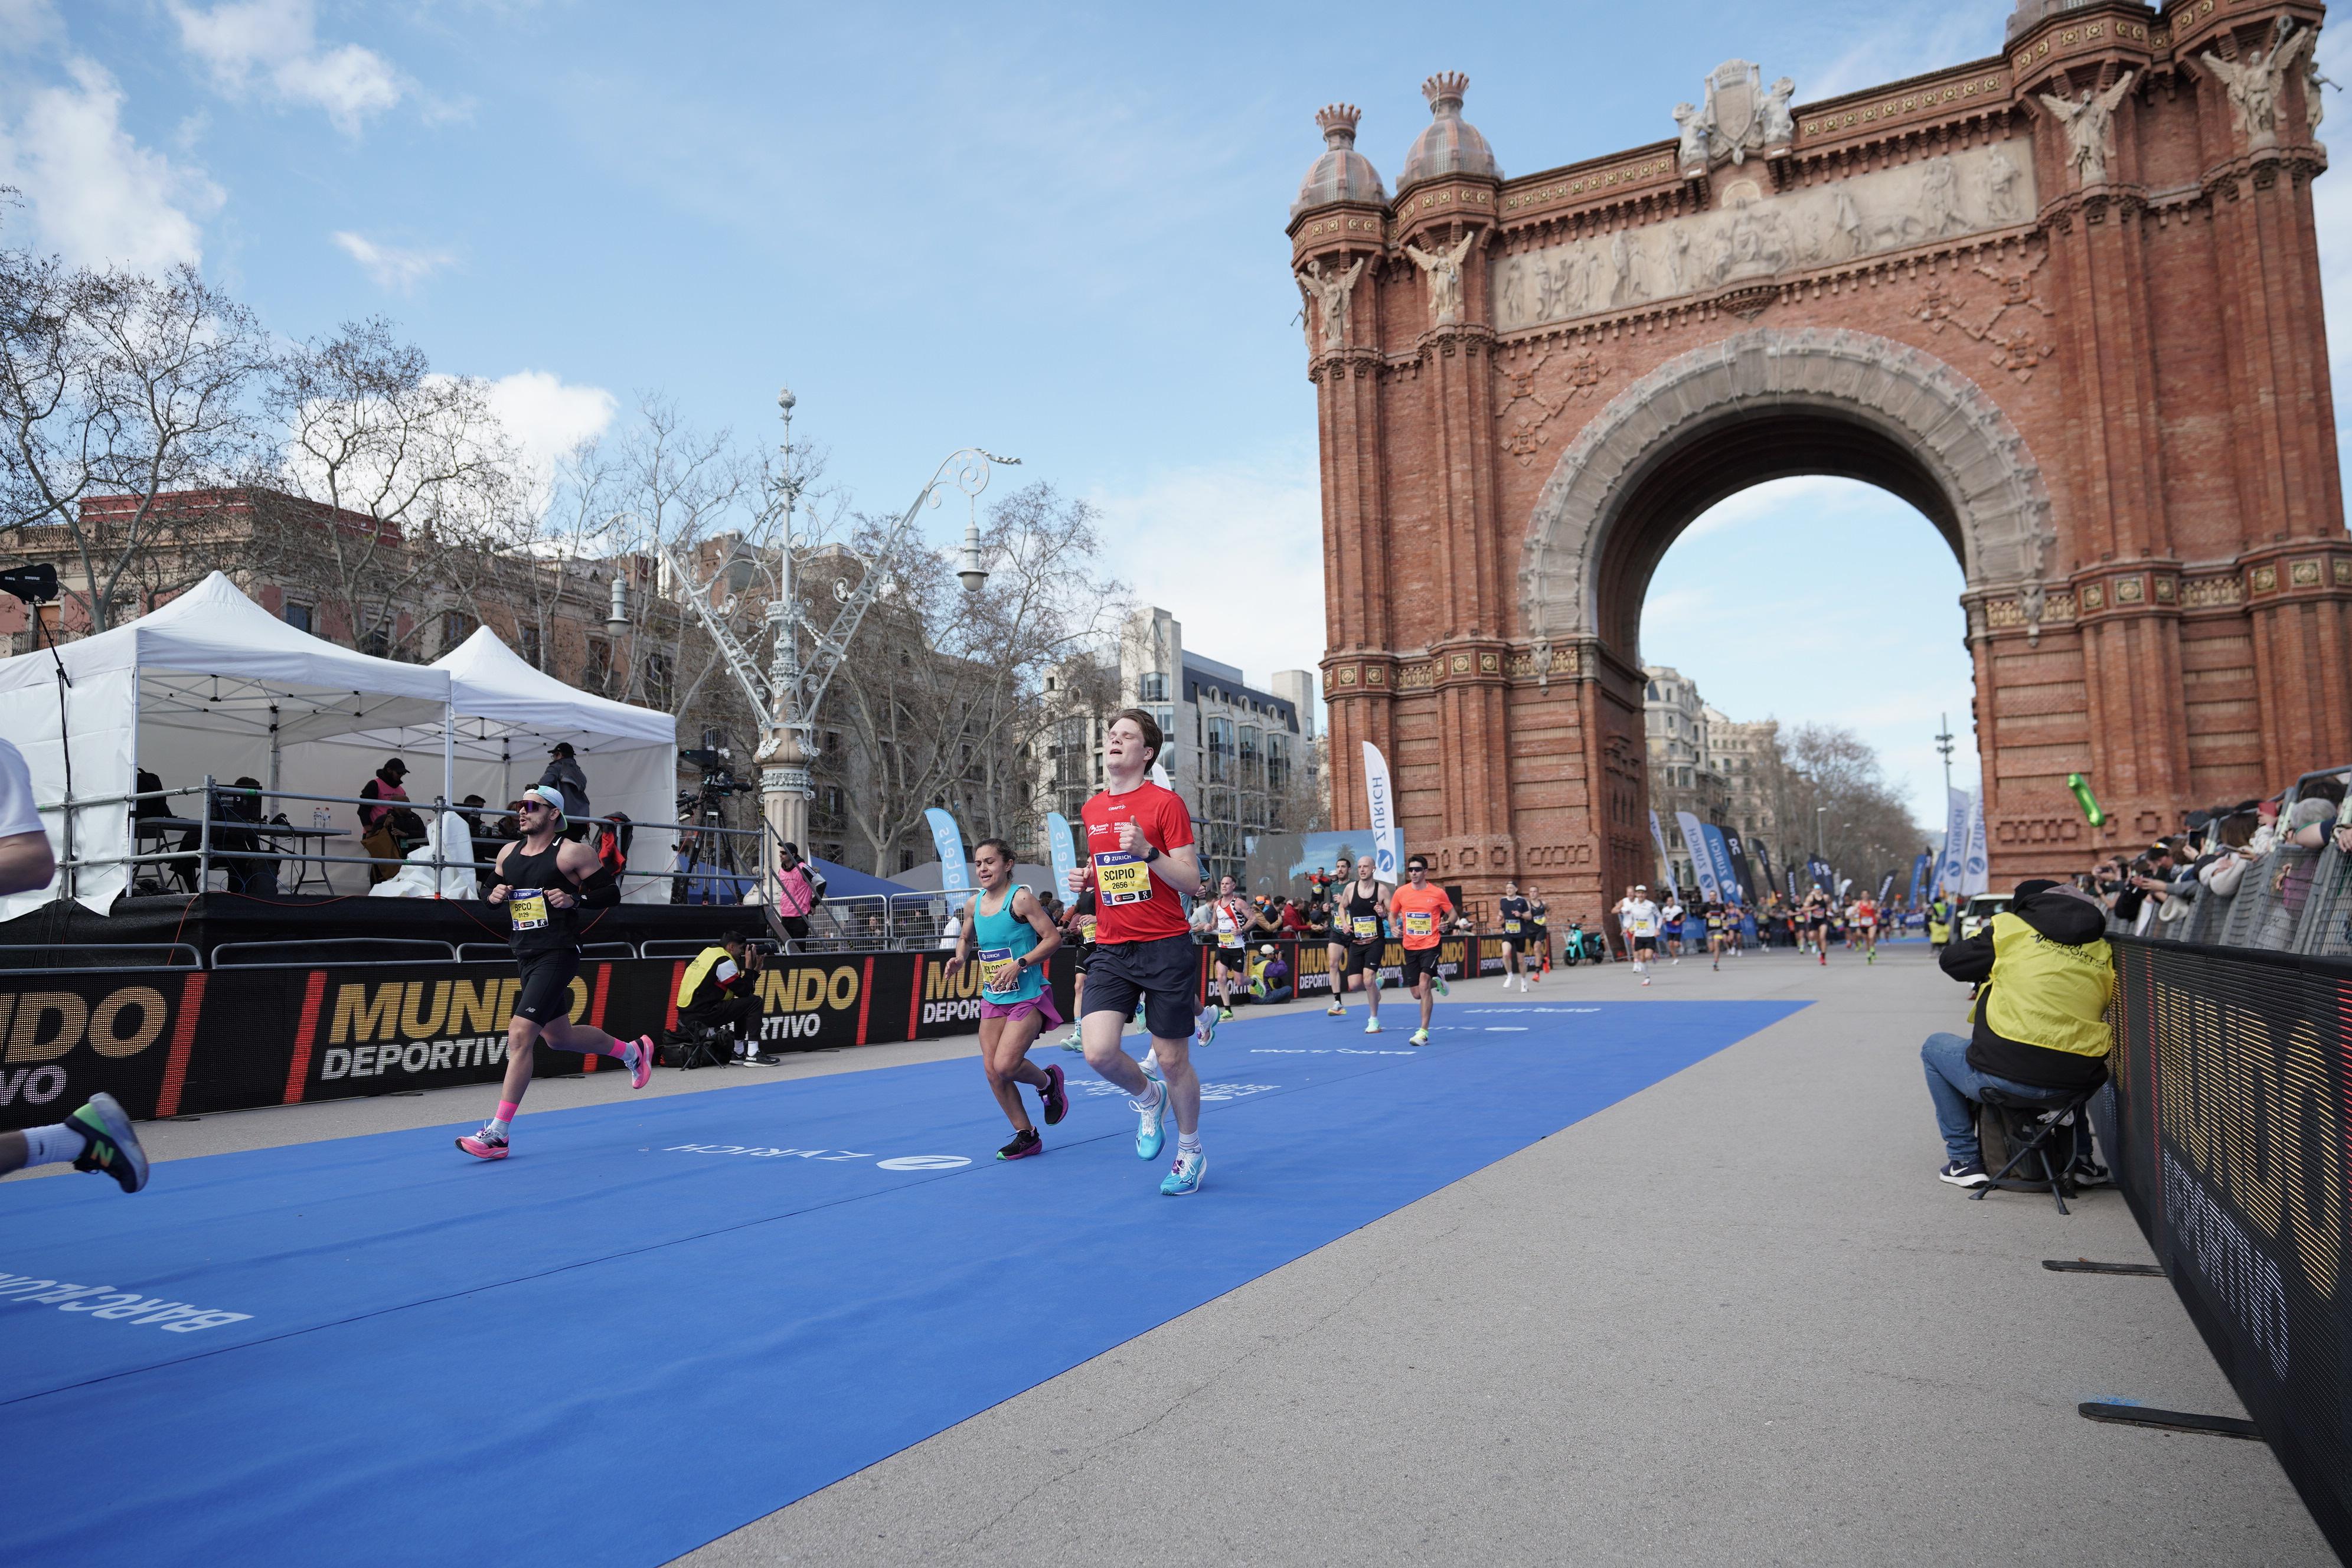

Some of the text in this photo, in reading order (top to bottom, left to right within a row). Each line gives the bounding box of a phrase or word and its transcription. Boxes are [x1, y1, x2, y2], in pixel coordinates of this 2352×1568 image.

[1104, 868, 1135, 881] SCIPIO
[1112, 881, 1128, 890] 2656
[514, 902, 532, 912] BPCO
